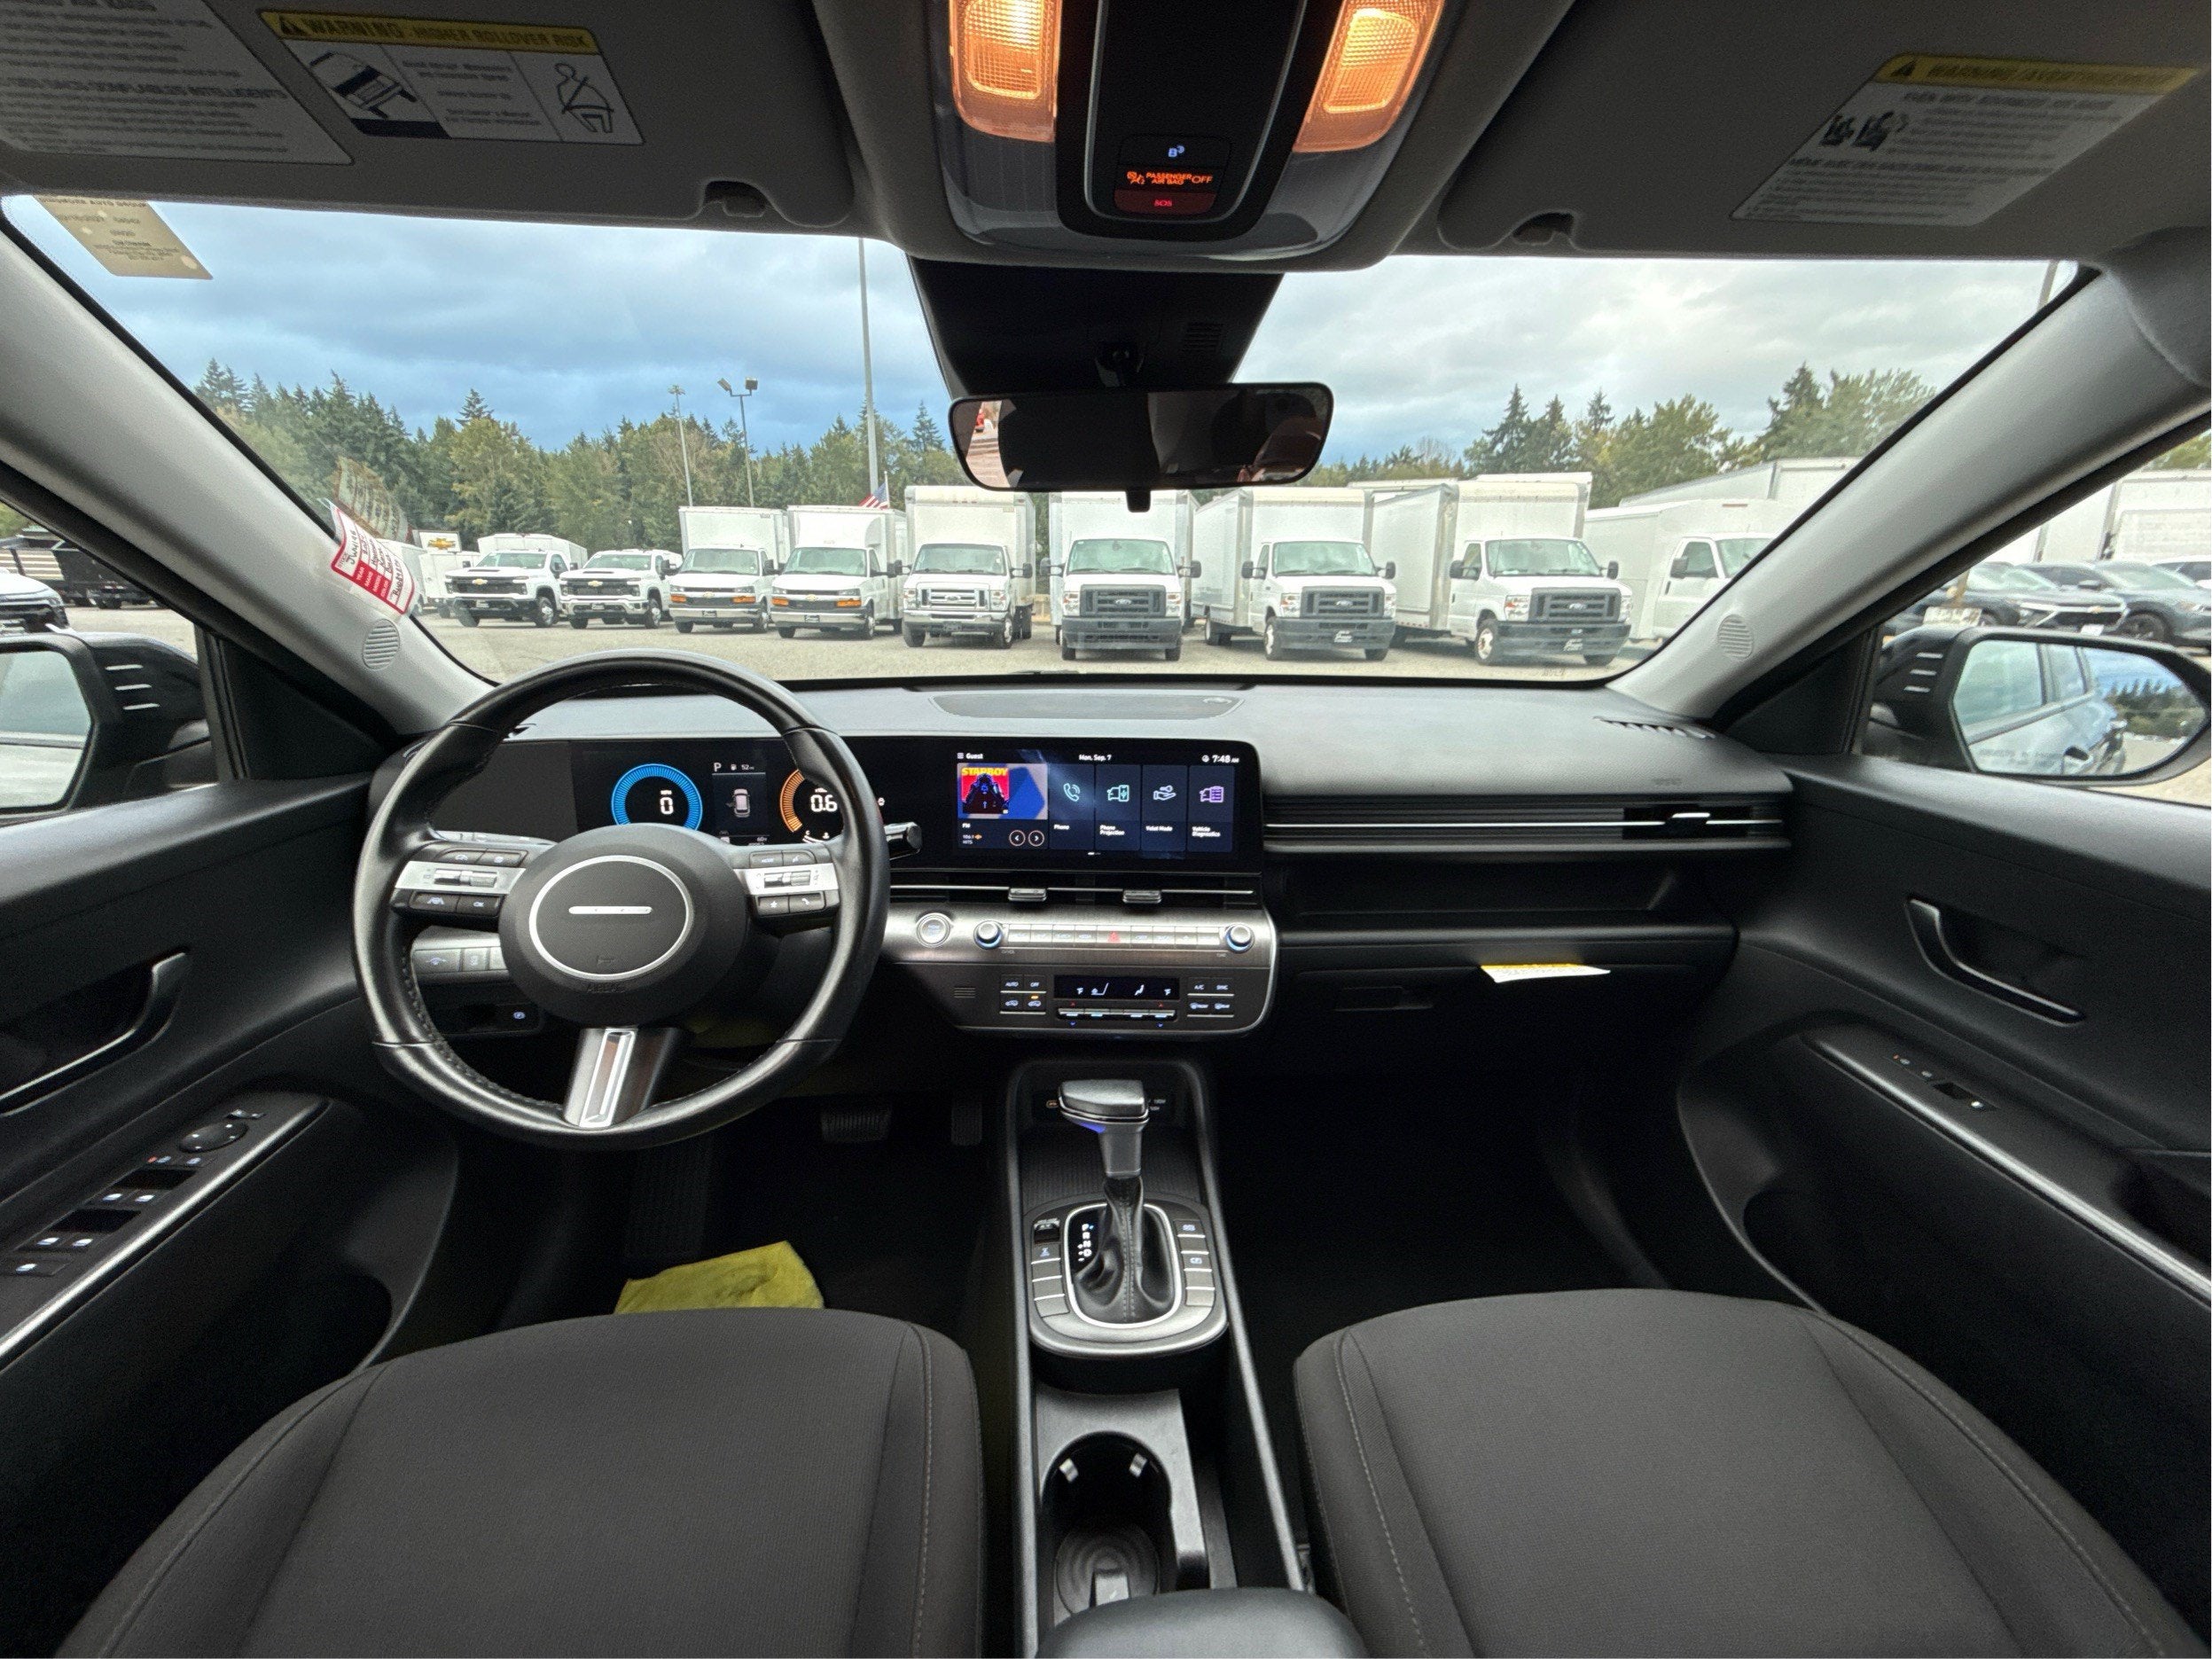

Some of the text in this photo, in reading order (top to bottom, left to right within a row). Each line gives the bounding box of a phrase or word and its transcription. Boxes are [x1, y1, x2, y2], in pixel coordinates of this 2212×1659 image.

[1192, 175, 1213, 184] OFF
[1212, 754, 1231, 763] 7:48
[713, 762, 722, 771] P
[660, 796, 674, 815] 0
[810, 794, 838, 812] 0.6
